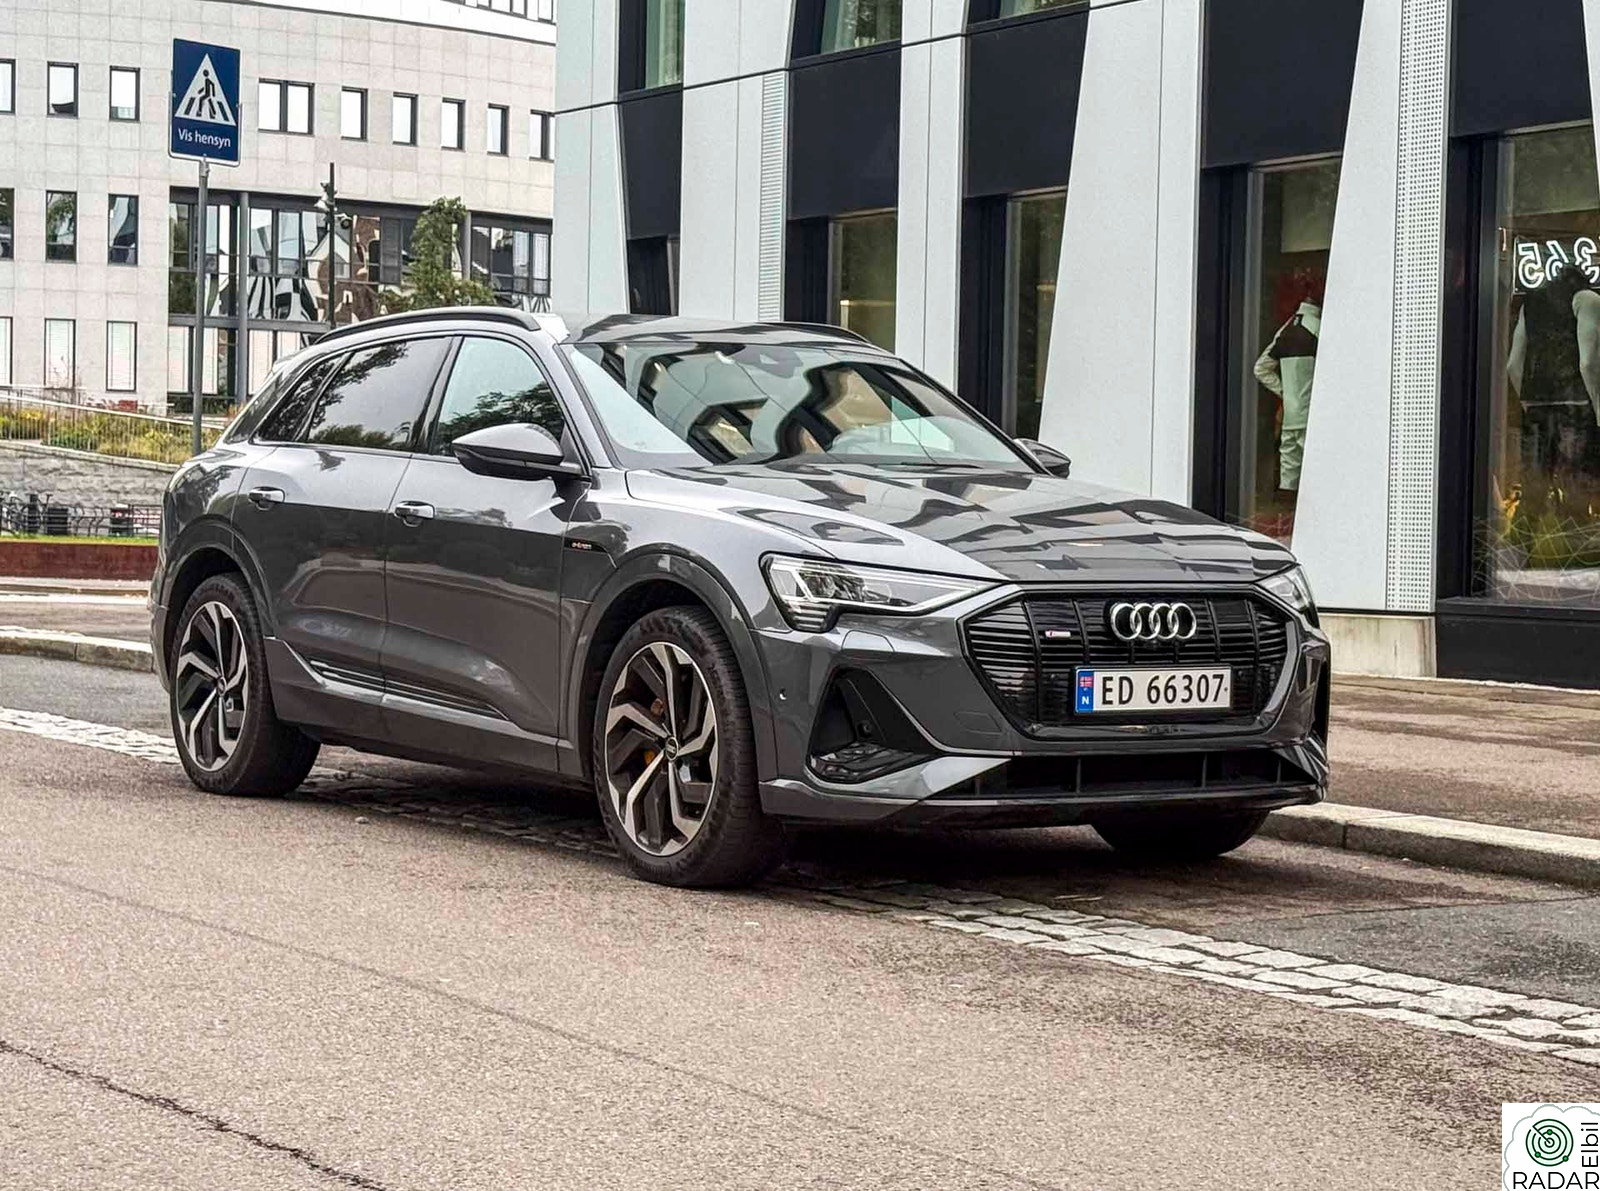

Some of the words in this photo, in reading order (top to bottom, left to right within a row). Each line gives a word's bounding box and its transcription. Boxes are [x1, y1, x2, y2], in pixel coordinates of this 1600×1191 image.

[178, 128, 193, 142] Vis
[194, 129, 231, 150] hensyn
[1081, 695, 1090, 705] N
[1101, 675, 1134, 705] ED
[1146, 673, 1225, 704] 66307
